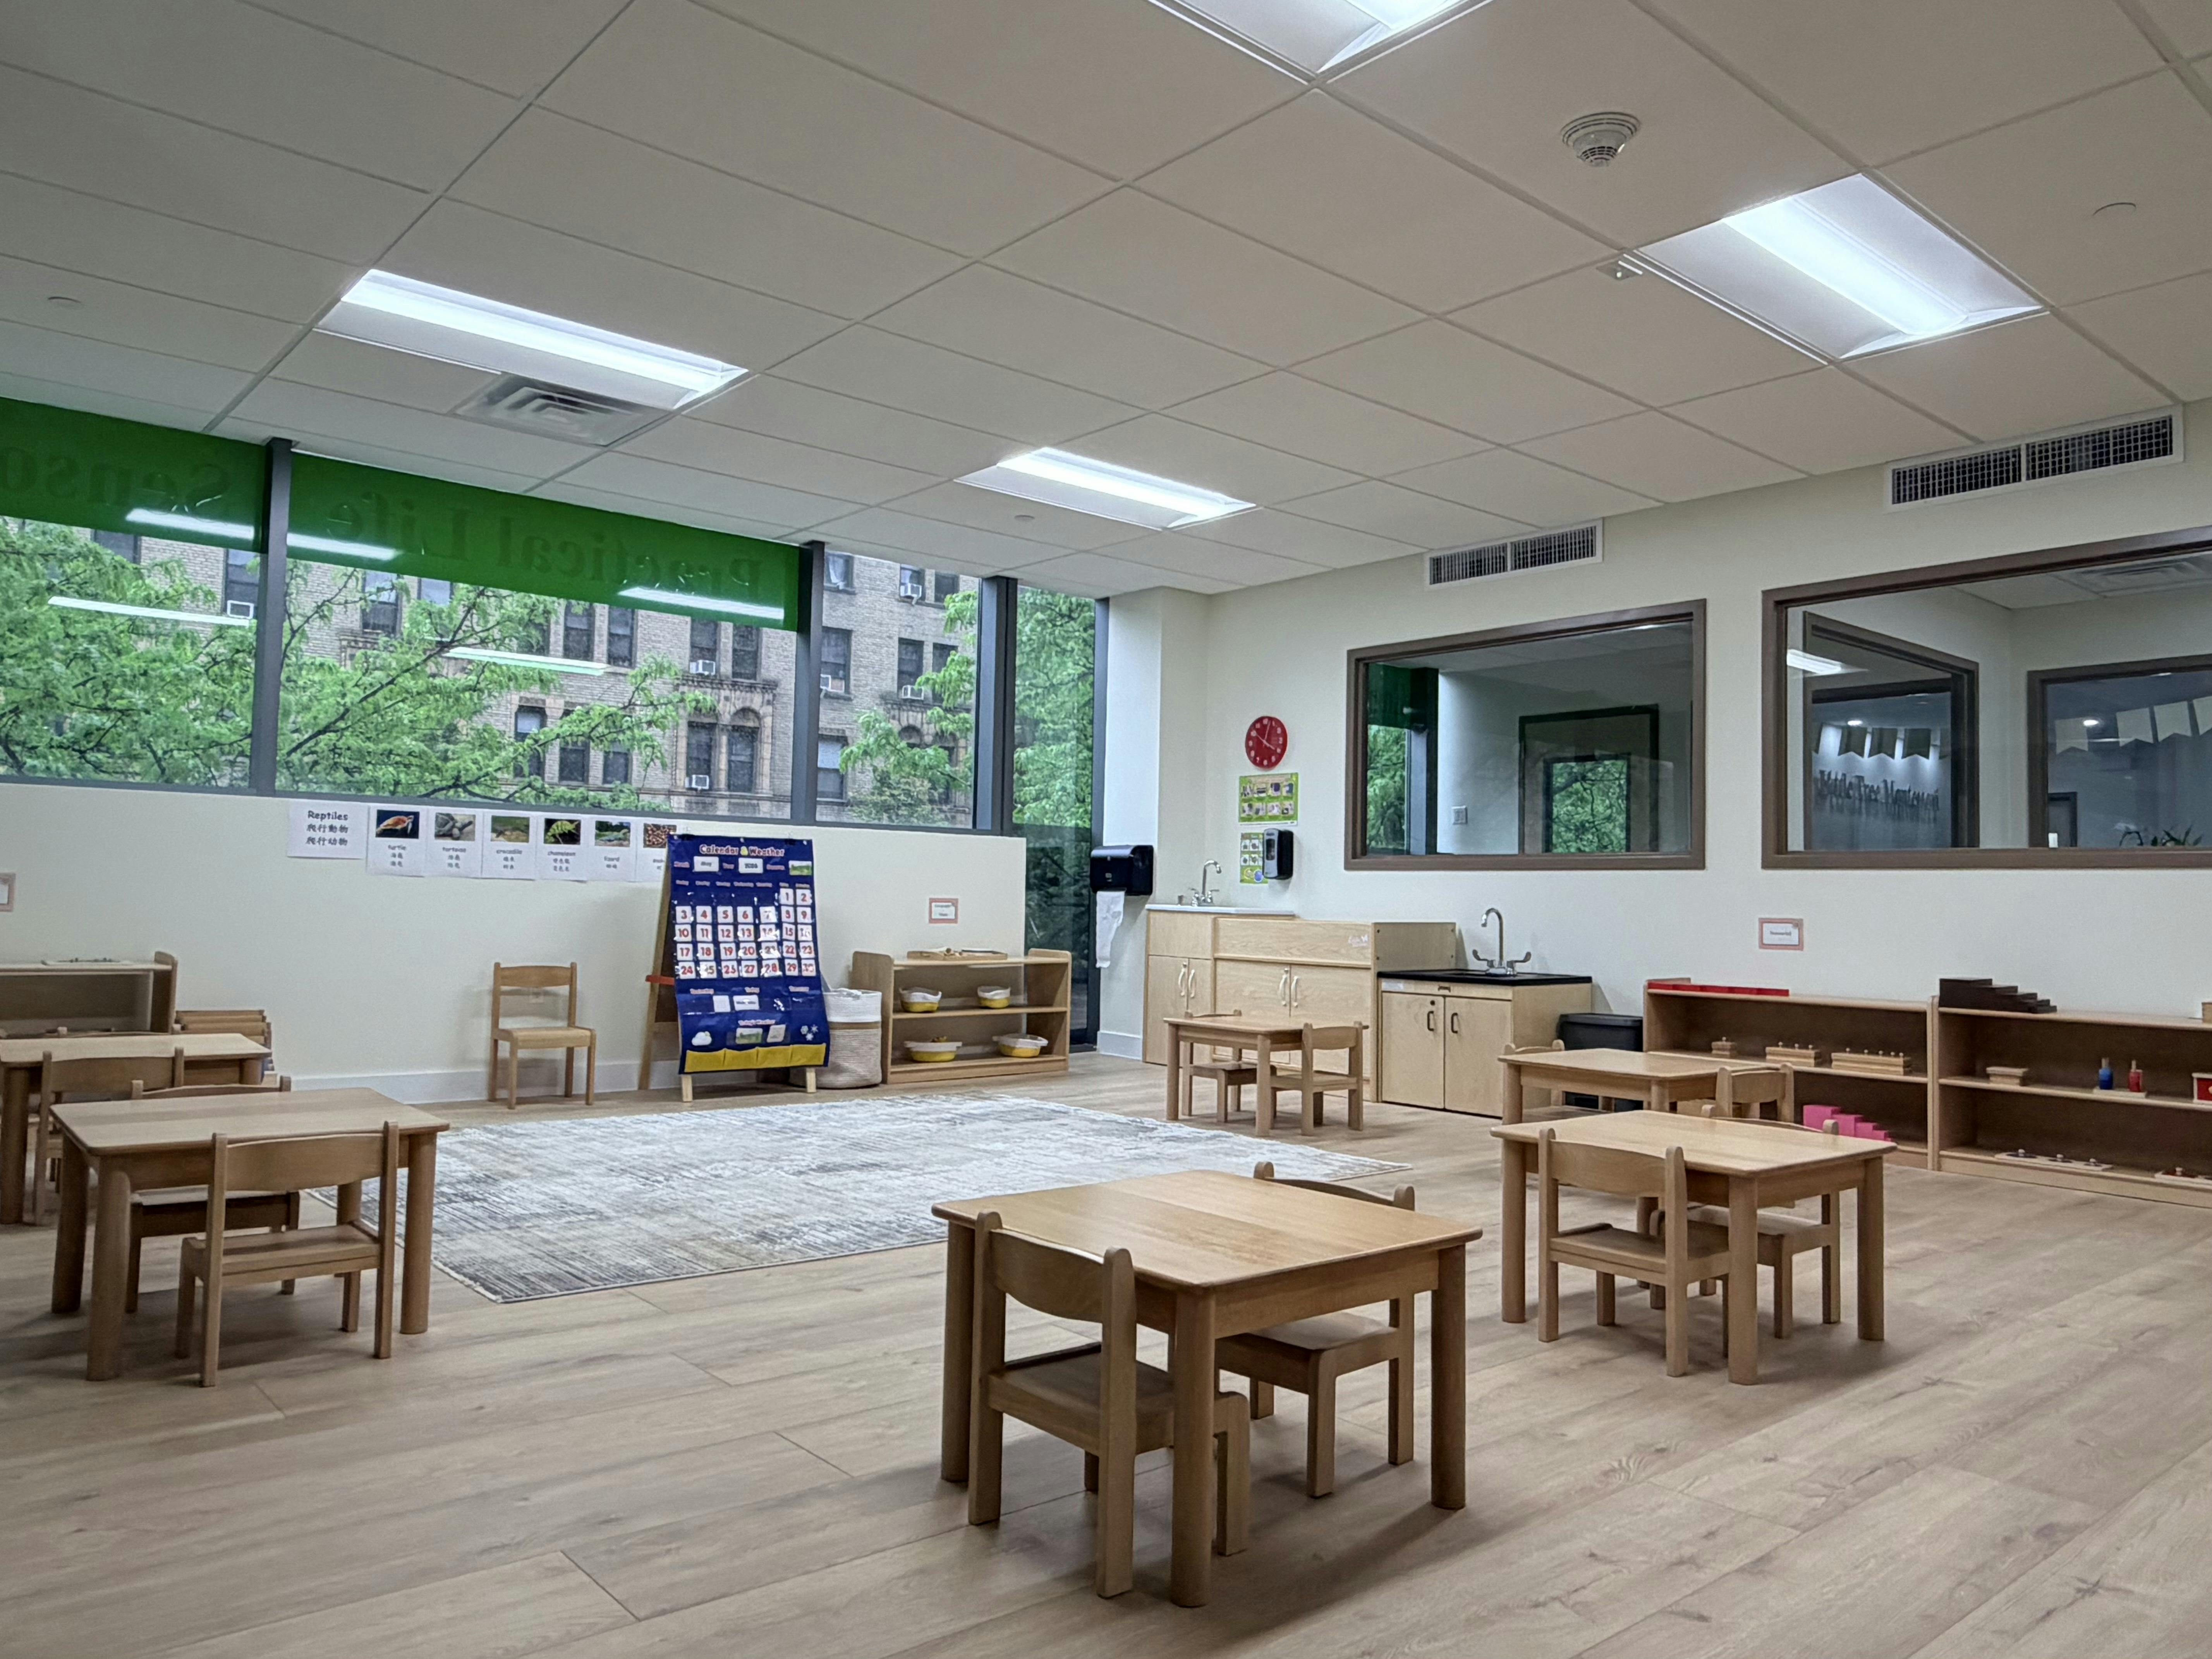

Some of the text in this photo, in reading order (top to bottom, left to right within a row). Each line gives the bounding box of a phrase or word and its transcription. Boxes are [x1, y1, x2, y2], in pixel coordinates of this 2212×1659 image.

[308, 810, 348, 822] Reptiles
[700, 844, 785, 857] Calendar Weather
[785, 892, 807, 902] 1 2
[681, 910, 687, 919] 3
[700, 910, 707, 919] 4
[723, 910, 729, 919] 5
[742, 910, 749, 919] 6
[801, 910, 807, 919] 9
[679, 929, 689, 938] 10
[700, 929, 709, 938] 11
[721, 929, 731, 938] 12
[742, 928, 752, 938] 13
[785, 927, 793, 936] 15
[680, 947, 690, 957] 17
[701, 947, 711, 956] 18
[723, 946, 733, 955] 19
[743, 946, 755, 955] 20
[785, 945, 795, 954] 22
[801, 946, 812, 954] 23
[681, 966, 693, 975] 24
[744, 965, 755, 974] 27
[787, 962, 797, 972] 29
